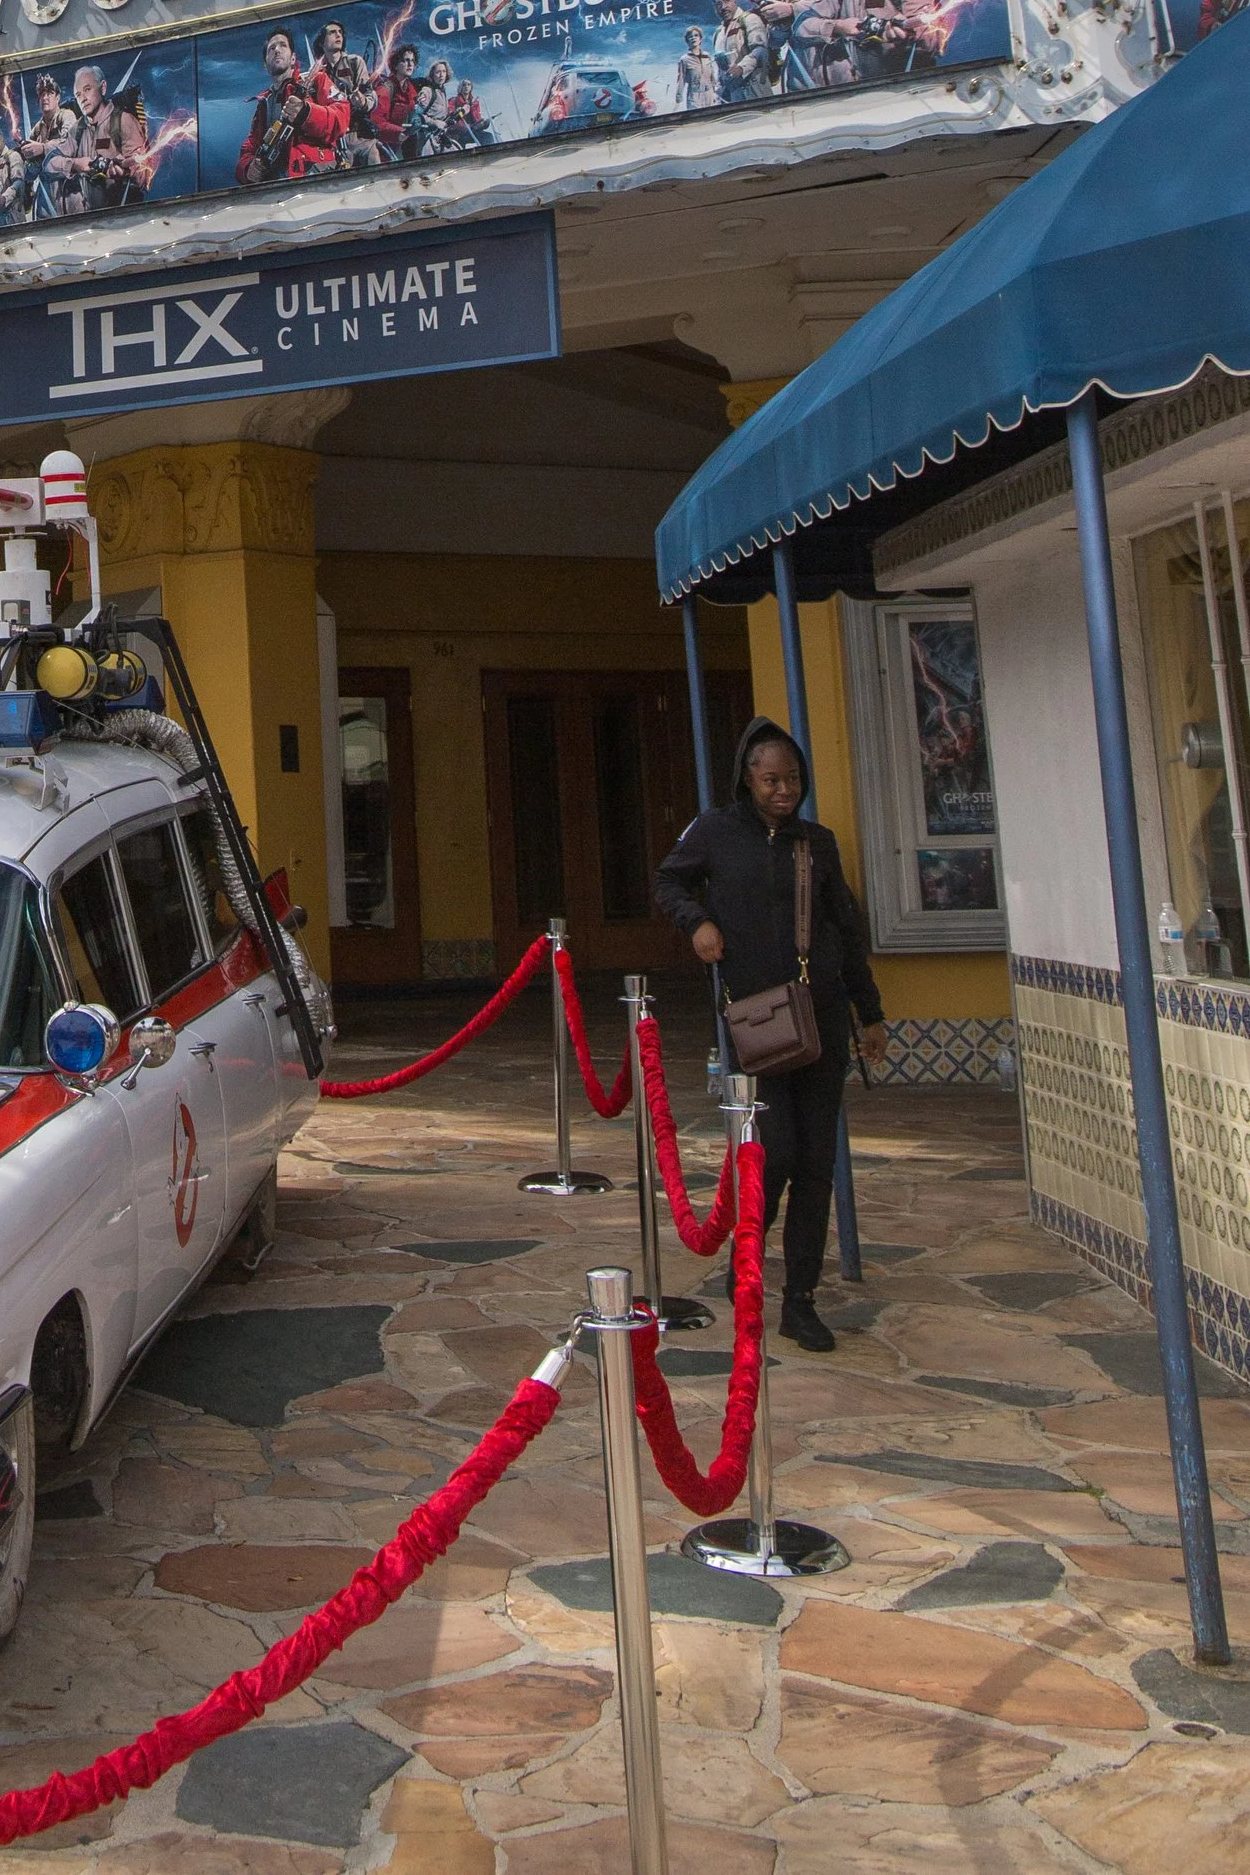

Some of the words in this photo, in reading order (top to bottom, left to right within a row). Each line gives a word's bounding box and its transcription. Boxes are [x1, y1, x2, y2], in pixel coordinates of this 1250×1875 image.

[479, 19, 570, 50] FROZEN
[275, 257, 478, 320] ULTIMATE
[48, 272, 263, 398] THX
[278, 301, 479, 351] CINEMA
